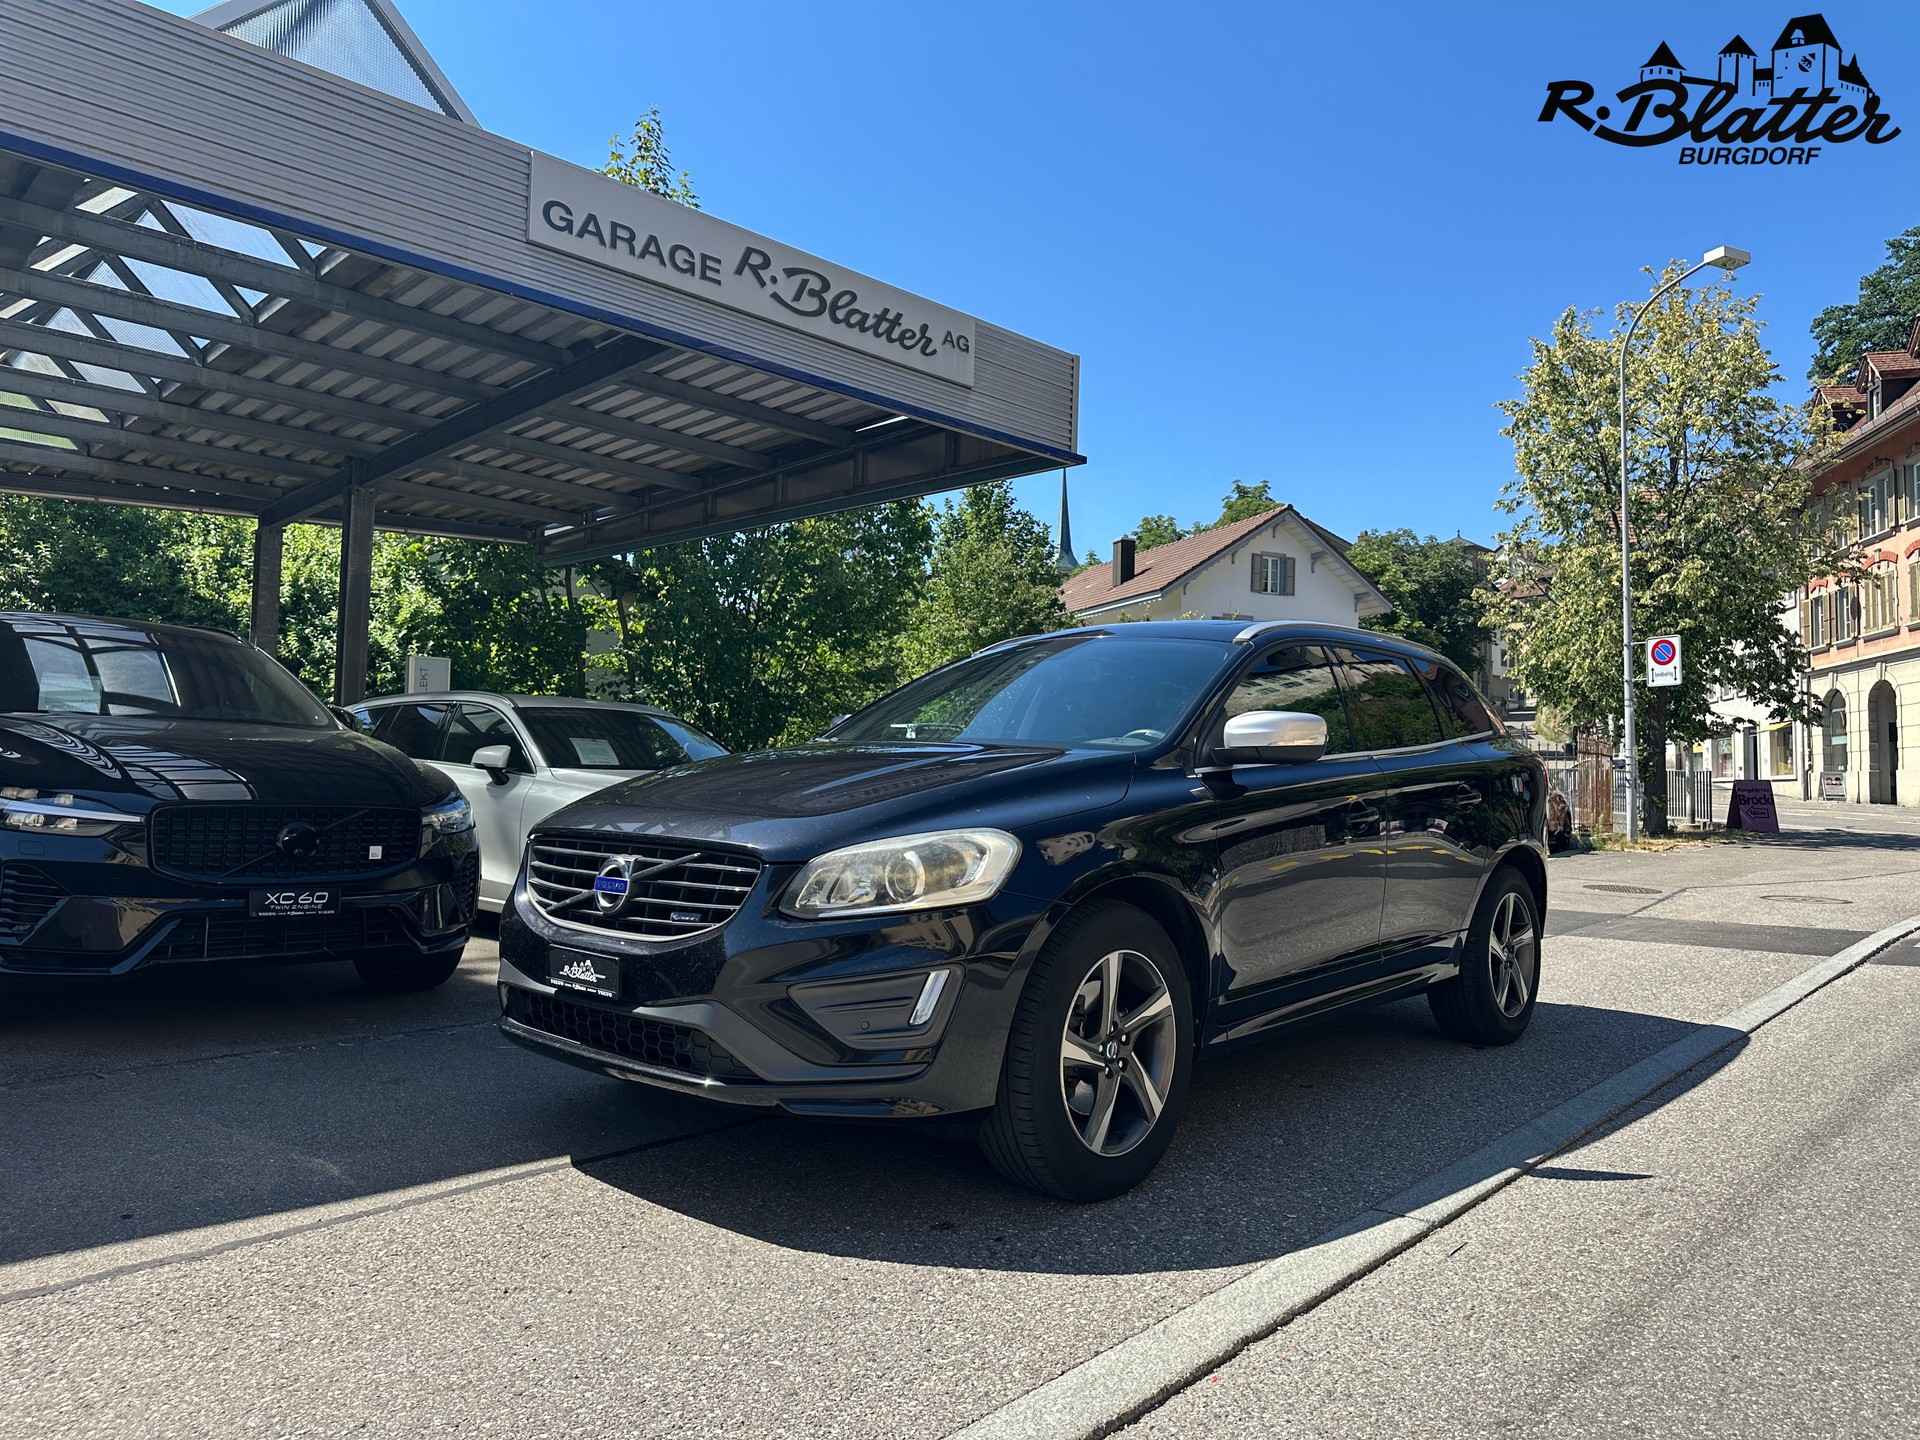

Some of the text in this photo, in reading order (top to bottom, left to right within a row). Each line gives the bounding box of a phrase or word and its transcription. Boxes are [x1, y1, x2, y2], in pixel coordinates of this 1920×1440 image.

[542, 200, 723, 287] GARAGE
[942, 329, 970, 354] AG
[419, 666, 428, 693] EKT
[597, 880, 625, 891] VOLVO
